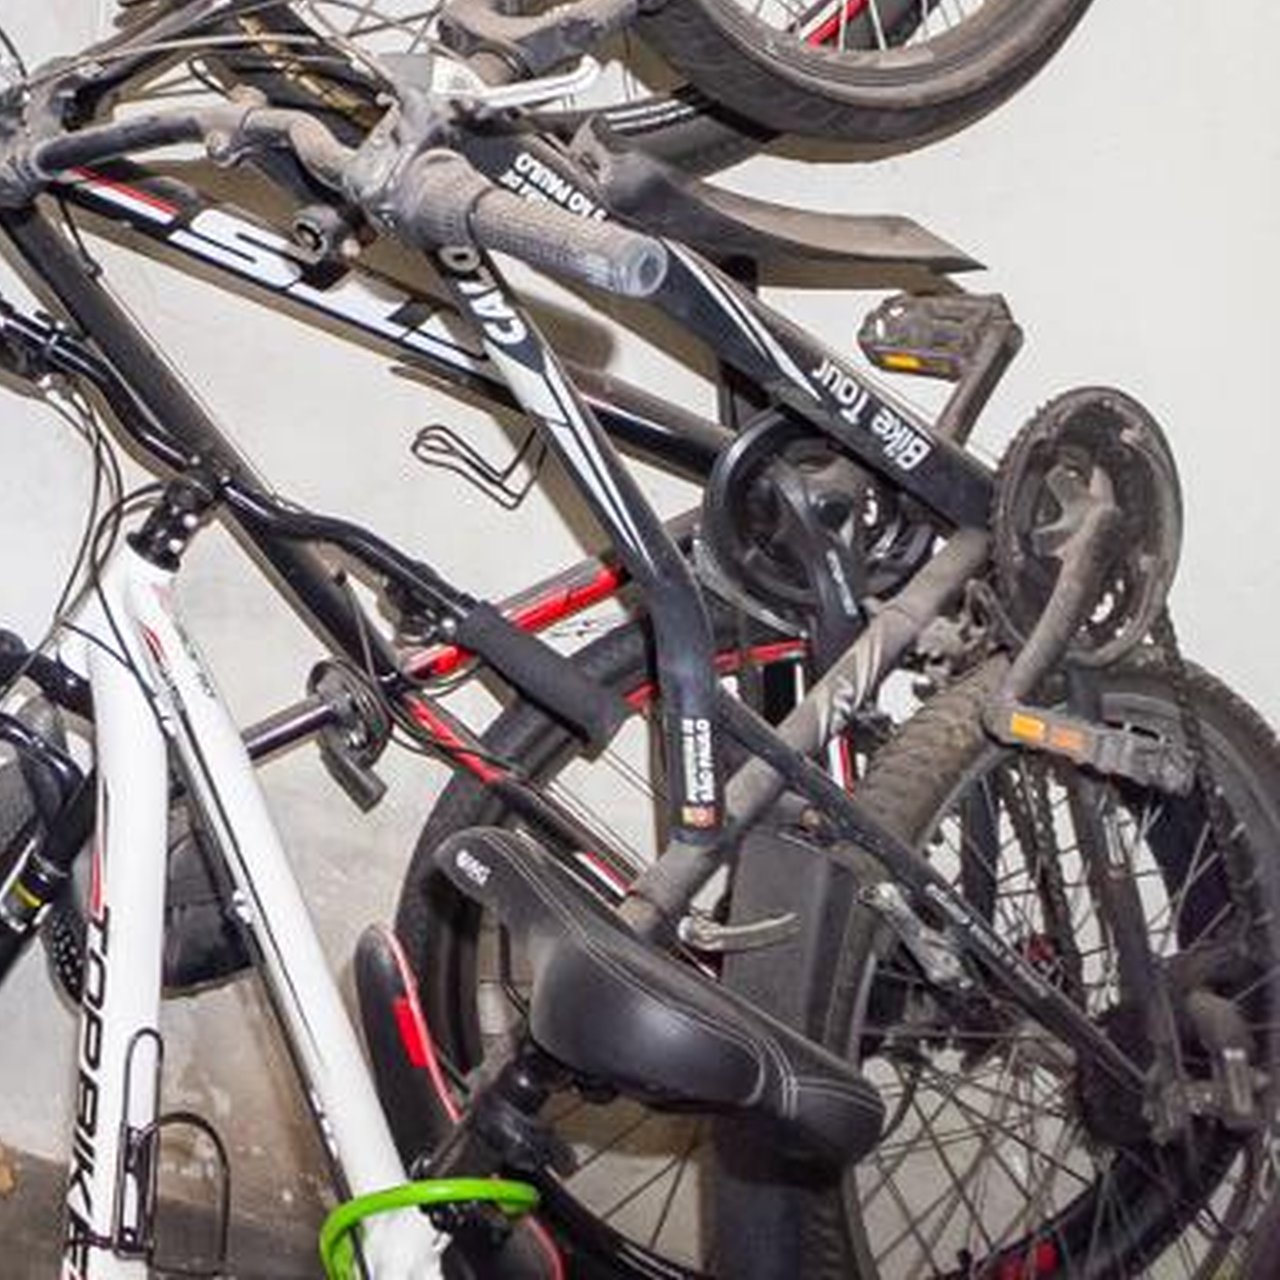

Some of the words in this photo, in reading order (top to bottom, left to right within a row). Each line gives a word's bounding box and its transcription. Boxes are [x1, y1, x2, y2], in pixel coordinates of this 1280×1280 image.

[513, 151, 573, 204] PAULO
[440, 243, 527, 347] CALO
[811, 358, 870, 425] Tour
[870, 406, 933, 471] Bike
